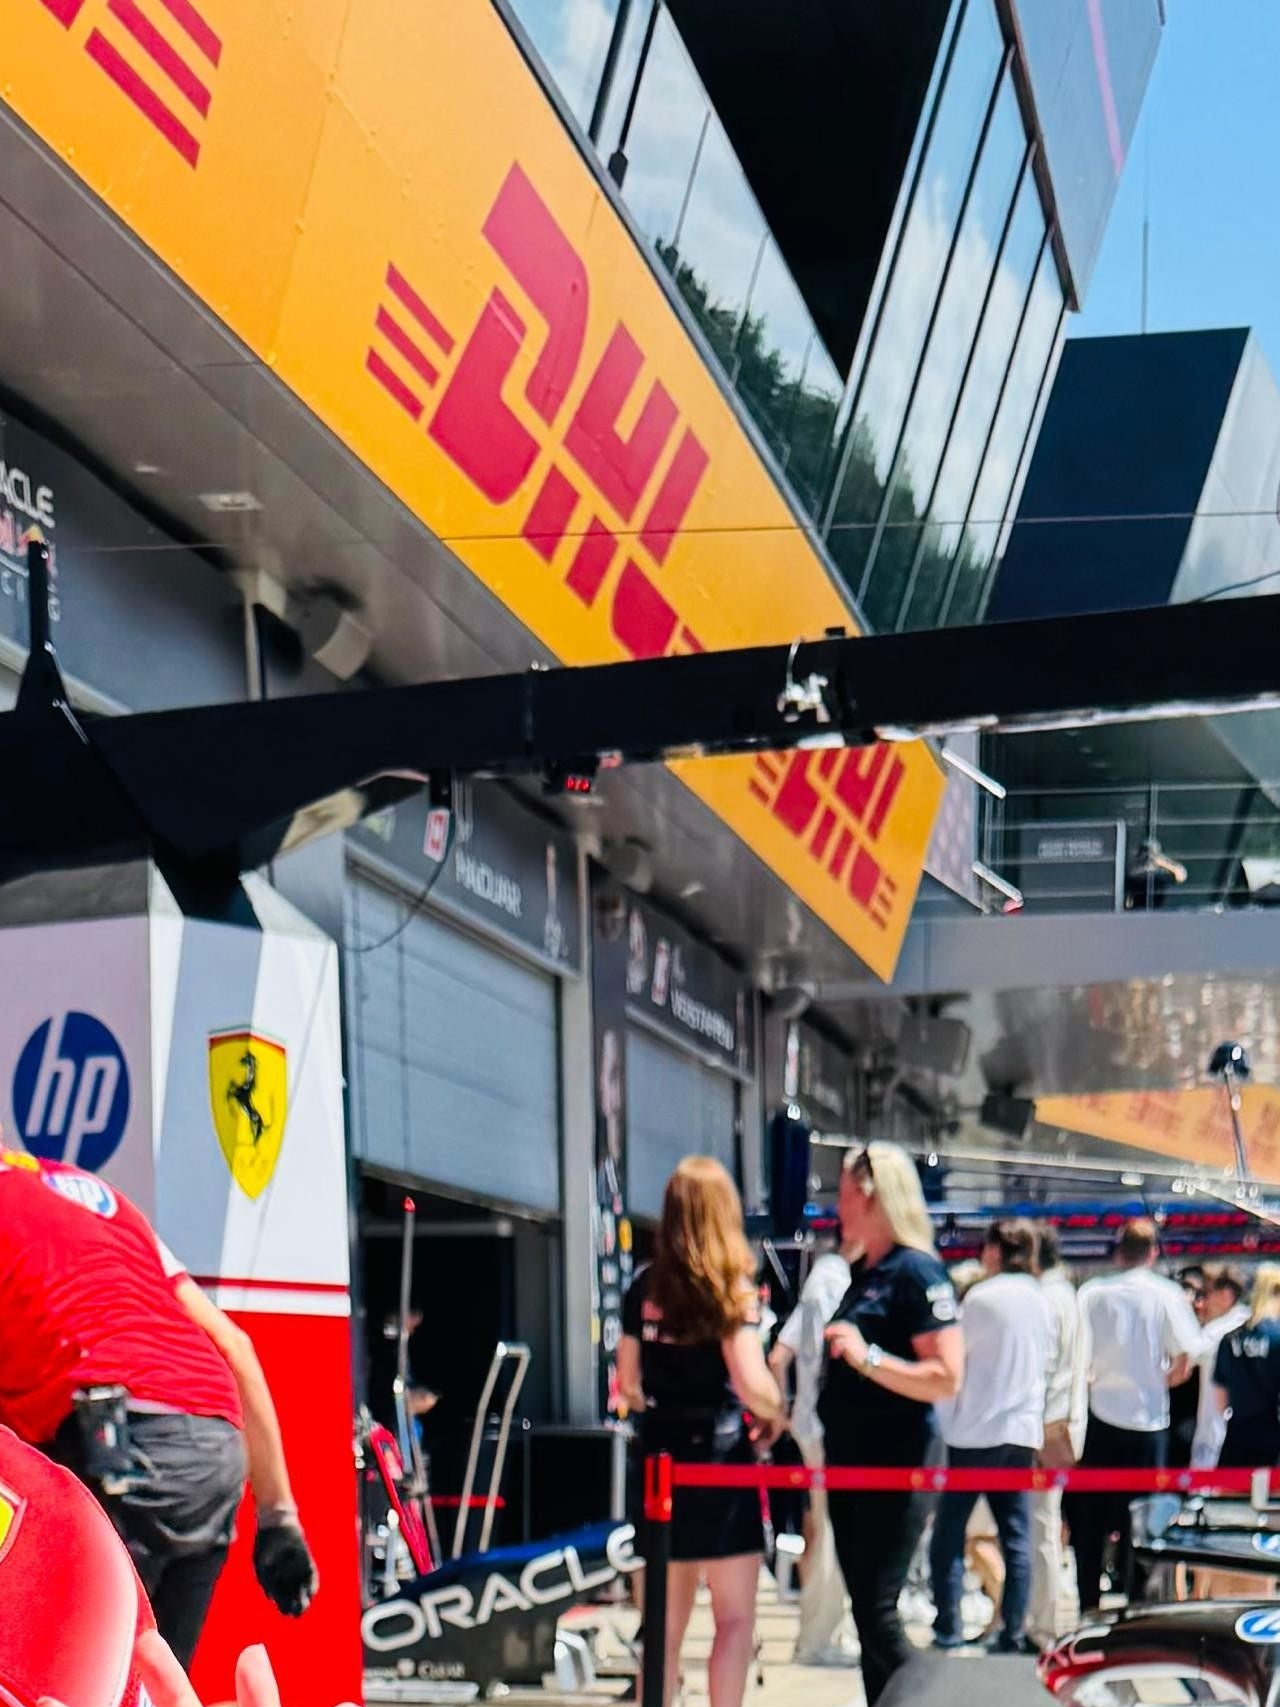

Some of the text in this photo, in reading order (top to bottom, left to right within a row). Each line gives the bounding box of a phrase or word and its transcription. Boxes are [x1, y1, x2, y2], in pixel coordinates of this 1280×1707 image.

[366, 159, 709, 660] DHL
[20, 1012, 122, 1170] hp
[360, 1523, 647, 1651] ORACLE
